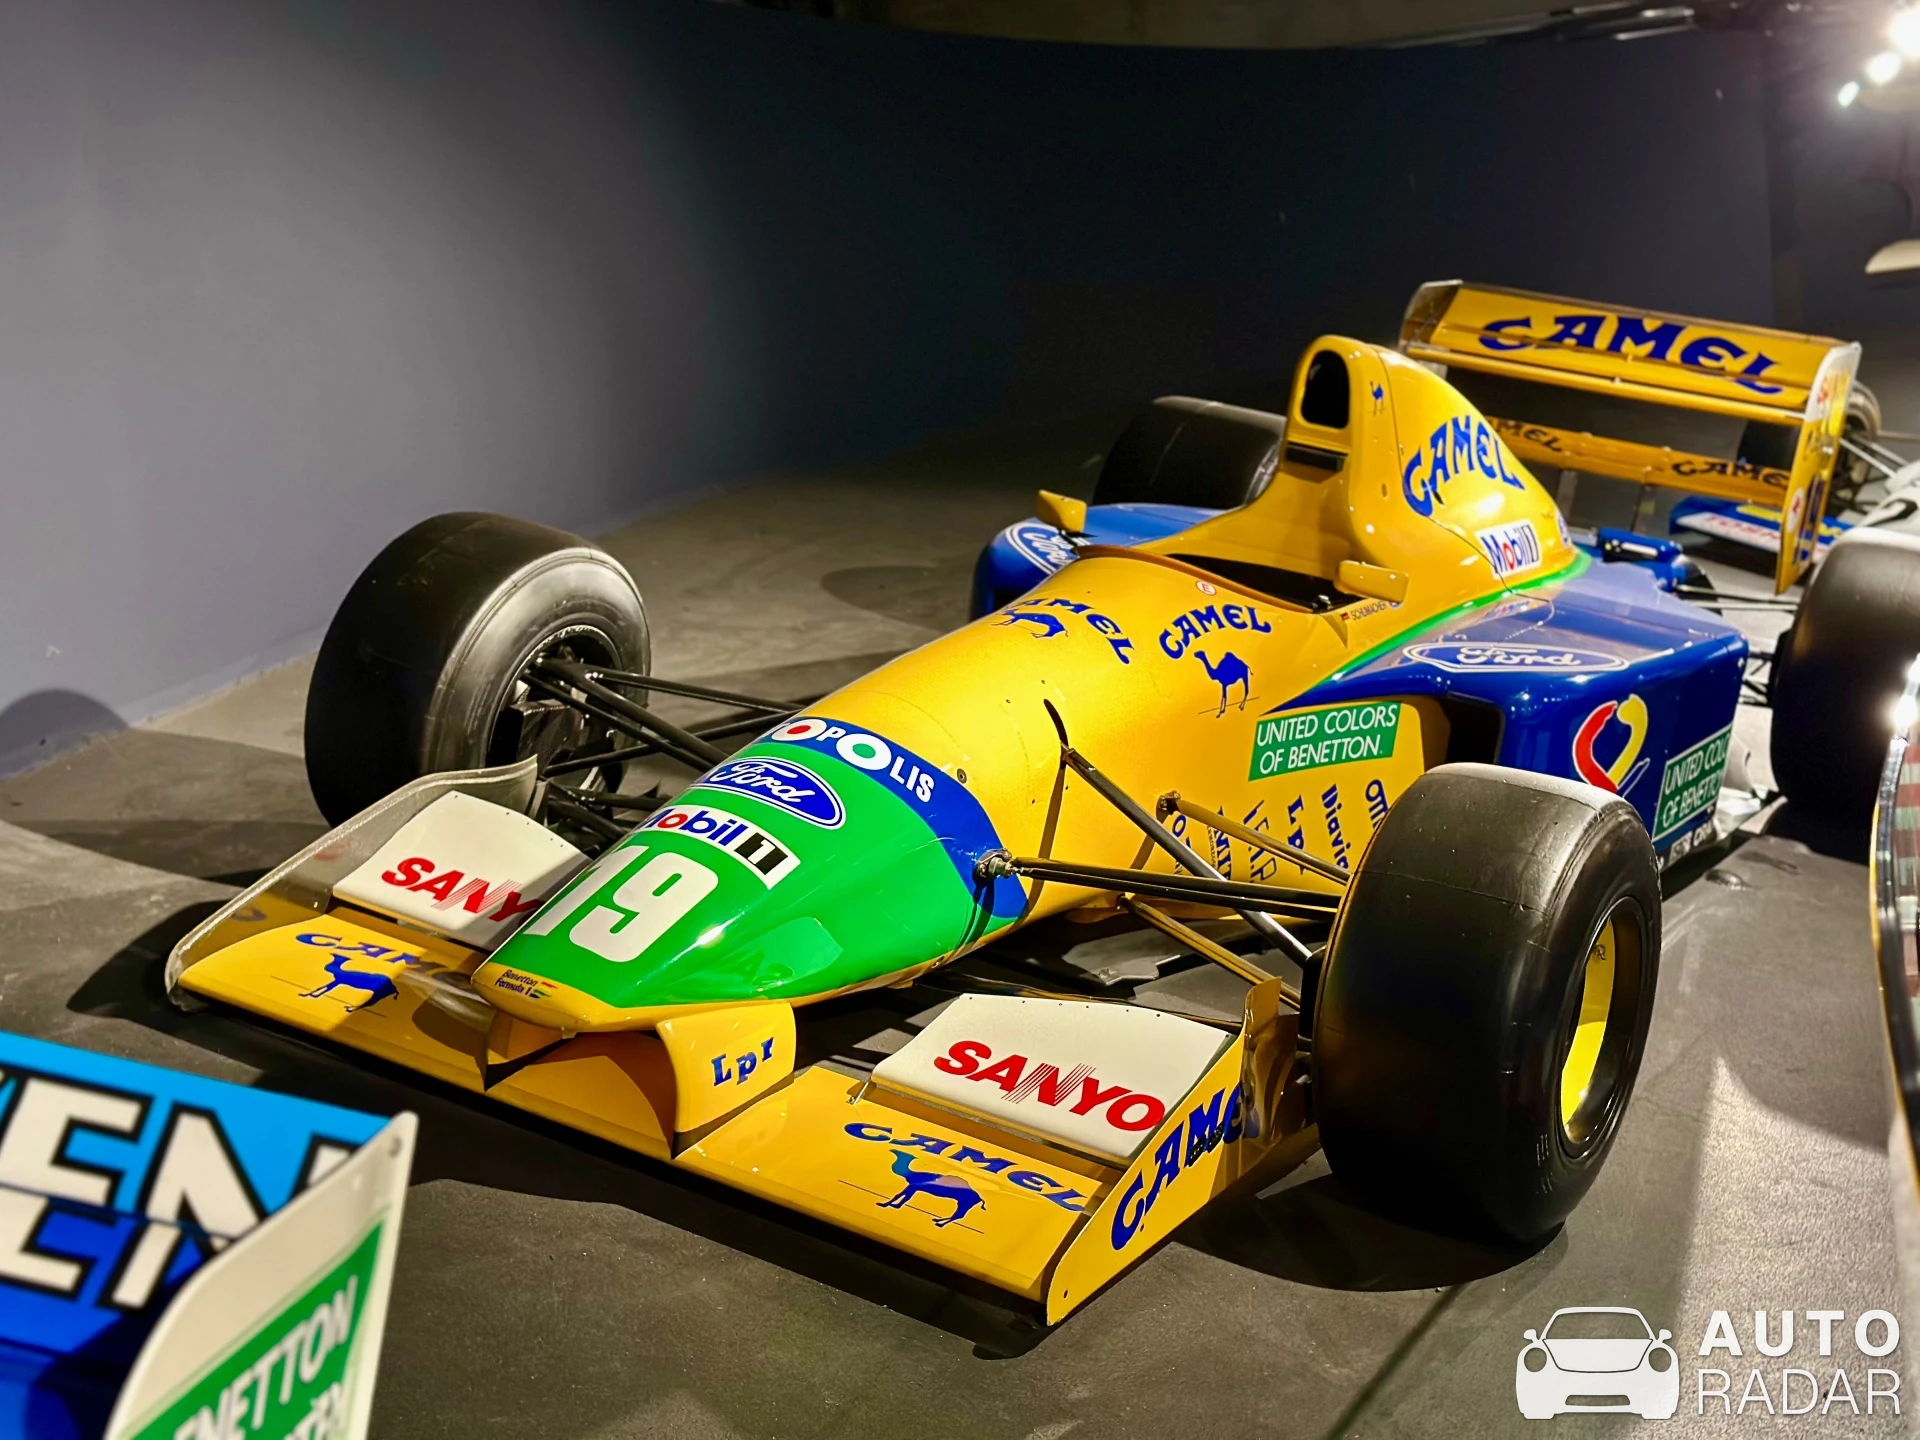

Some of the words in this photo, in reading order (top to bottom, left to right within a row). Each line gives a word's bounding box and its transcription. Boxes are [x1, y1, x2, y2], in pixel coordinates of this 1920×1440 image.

[1478, 314, 1782, 395] CAMEL
[1402, 414, 1526, 517] CAMEL
[1481, 526, 1532, 574] Mobil
[1158, 603, 1272, 660] CAMEL
[1456, 645, 1582, 667] Ford
[1257, 714, 1318, 746] UNITED
[1324, 704, 1397, 734] COLORS
[709, 762, 816, 803] Ford
[1259, 749, 1285, 775] OF
[1665, 750, 1704, 795] UNITED
[1662, 796, 1681, 828] OF
[381, 857, 542, 925] SANY
[522, 845, 718, 963] 19
[494, 977, 525, 993] Formula
[502, 969, 539, 987] Benetton
[711, 1037, 774, 1087] Lpr
[934, 1040, 1166, 1132] SANYO
[844, 1122, 1088, 1212] CAMEL
